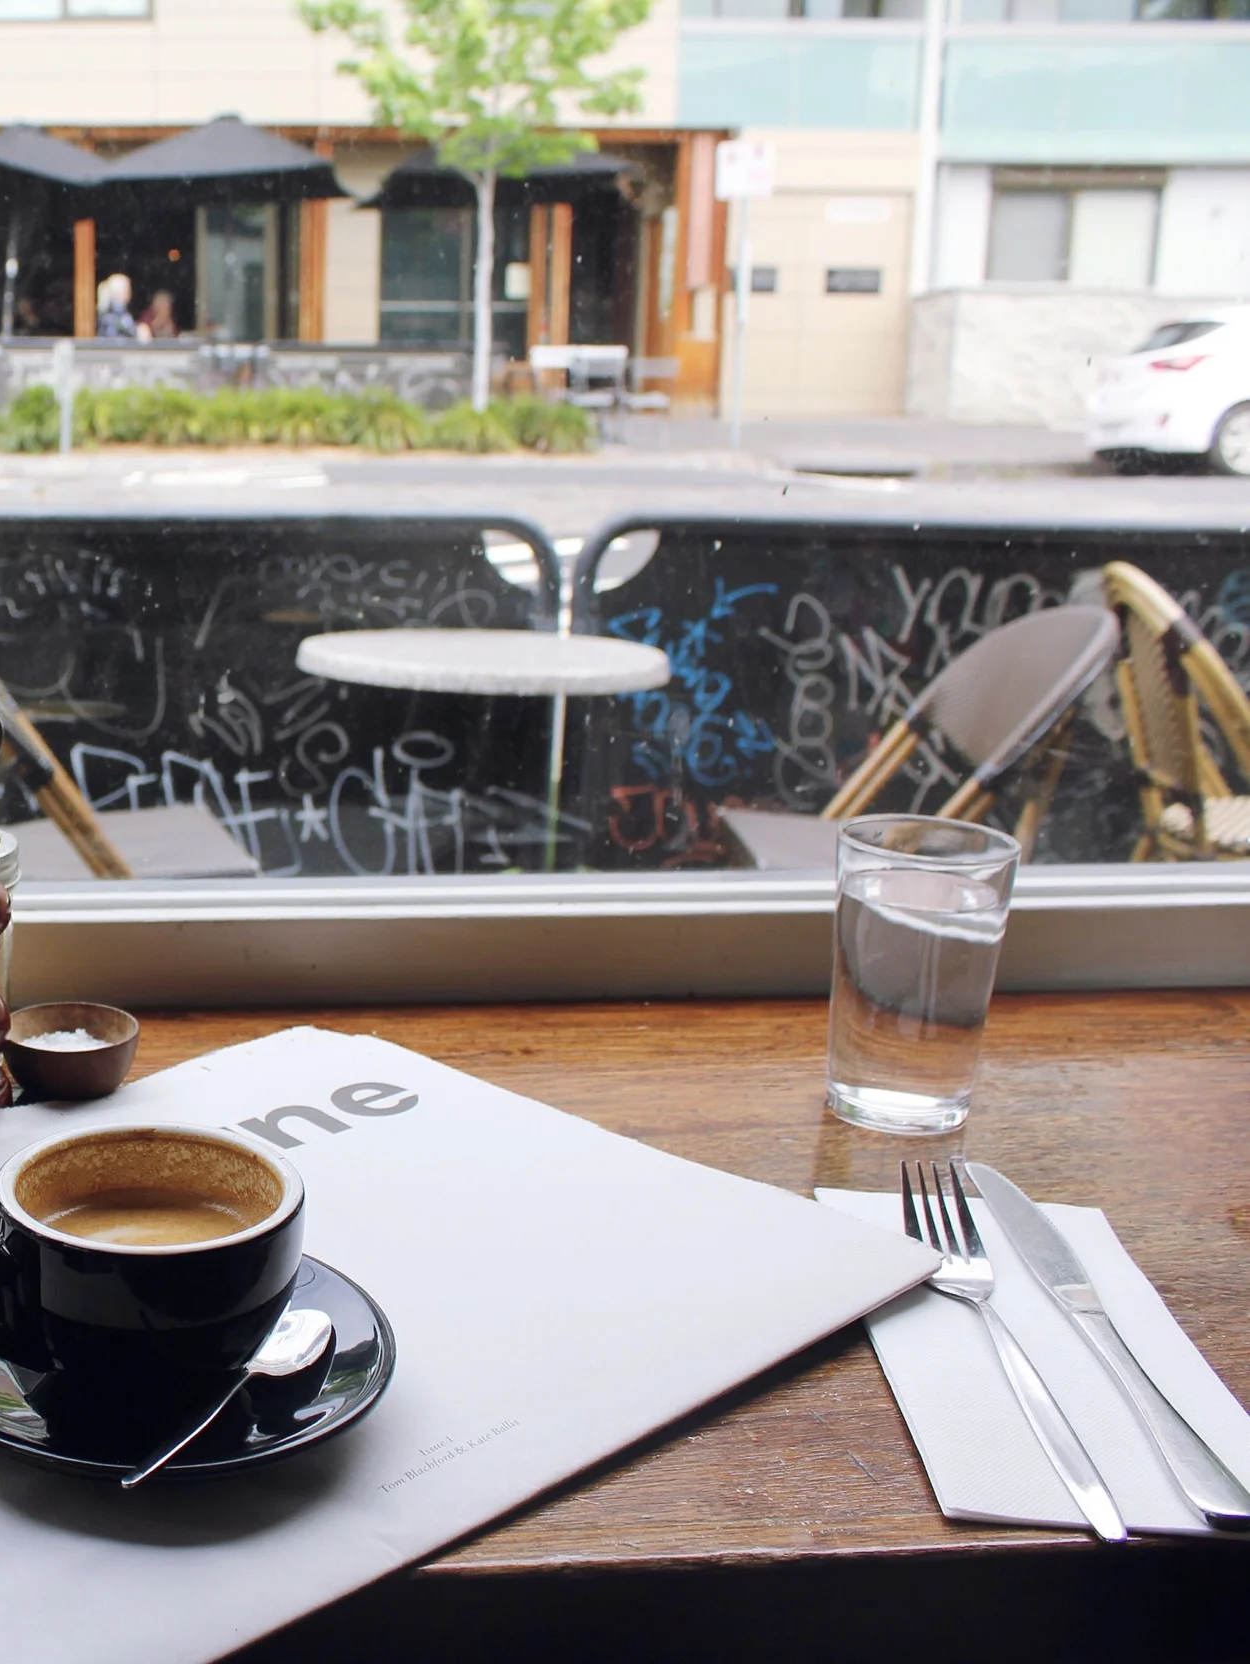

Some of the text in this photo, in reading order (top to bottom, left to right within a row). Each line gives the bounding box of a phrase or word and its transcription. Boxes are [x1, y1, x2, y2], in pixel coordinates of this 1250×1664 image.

[378, 1419, 521, 1494] Tom Blachford & Kate Ballis
[419, 1440, 447, 1457] Issue
